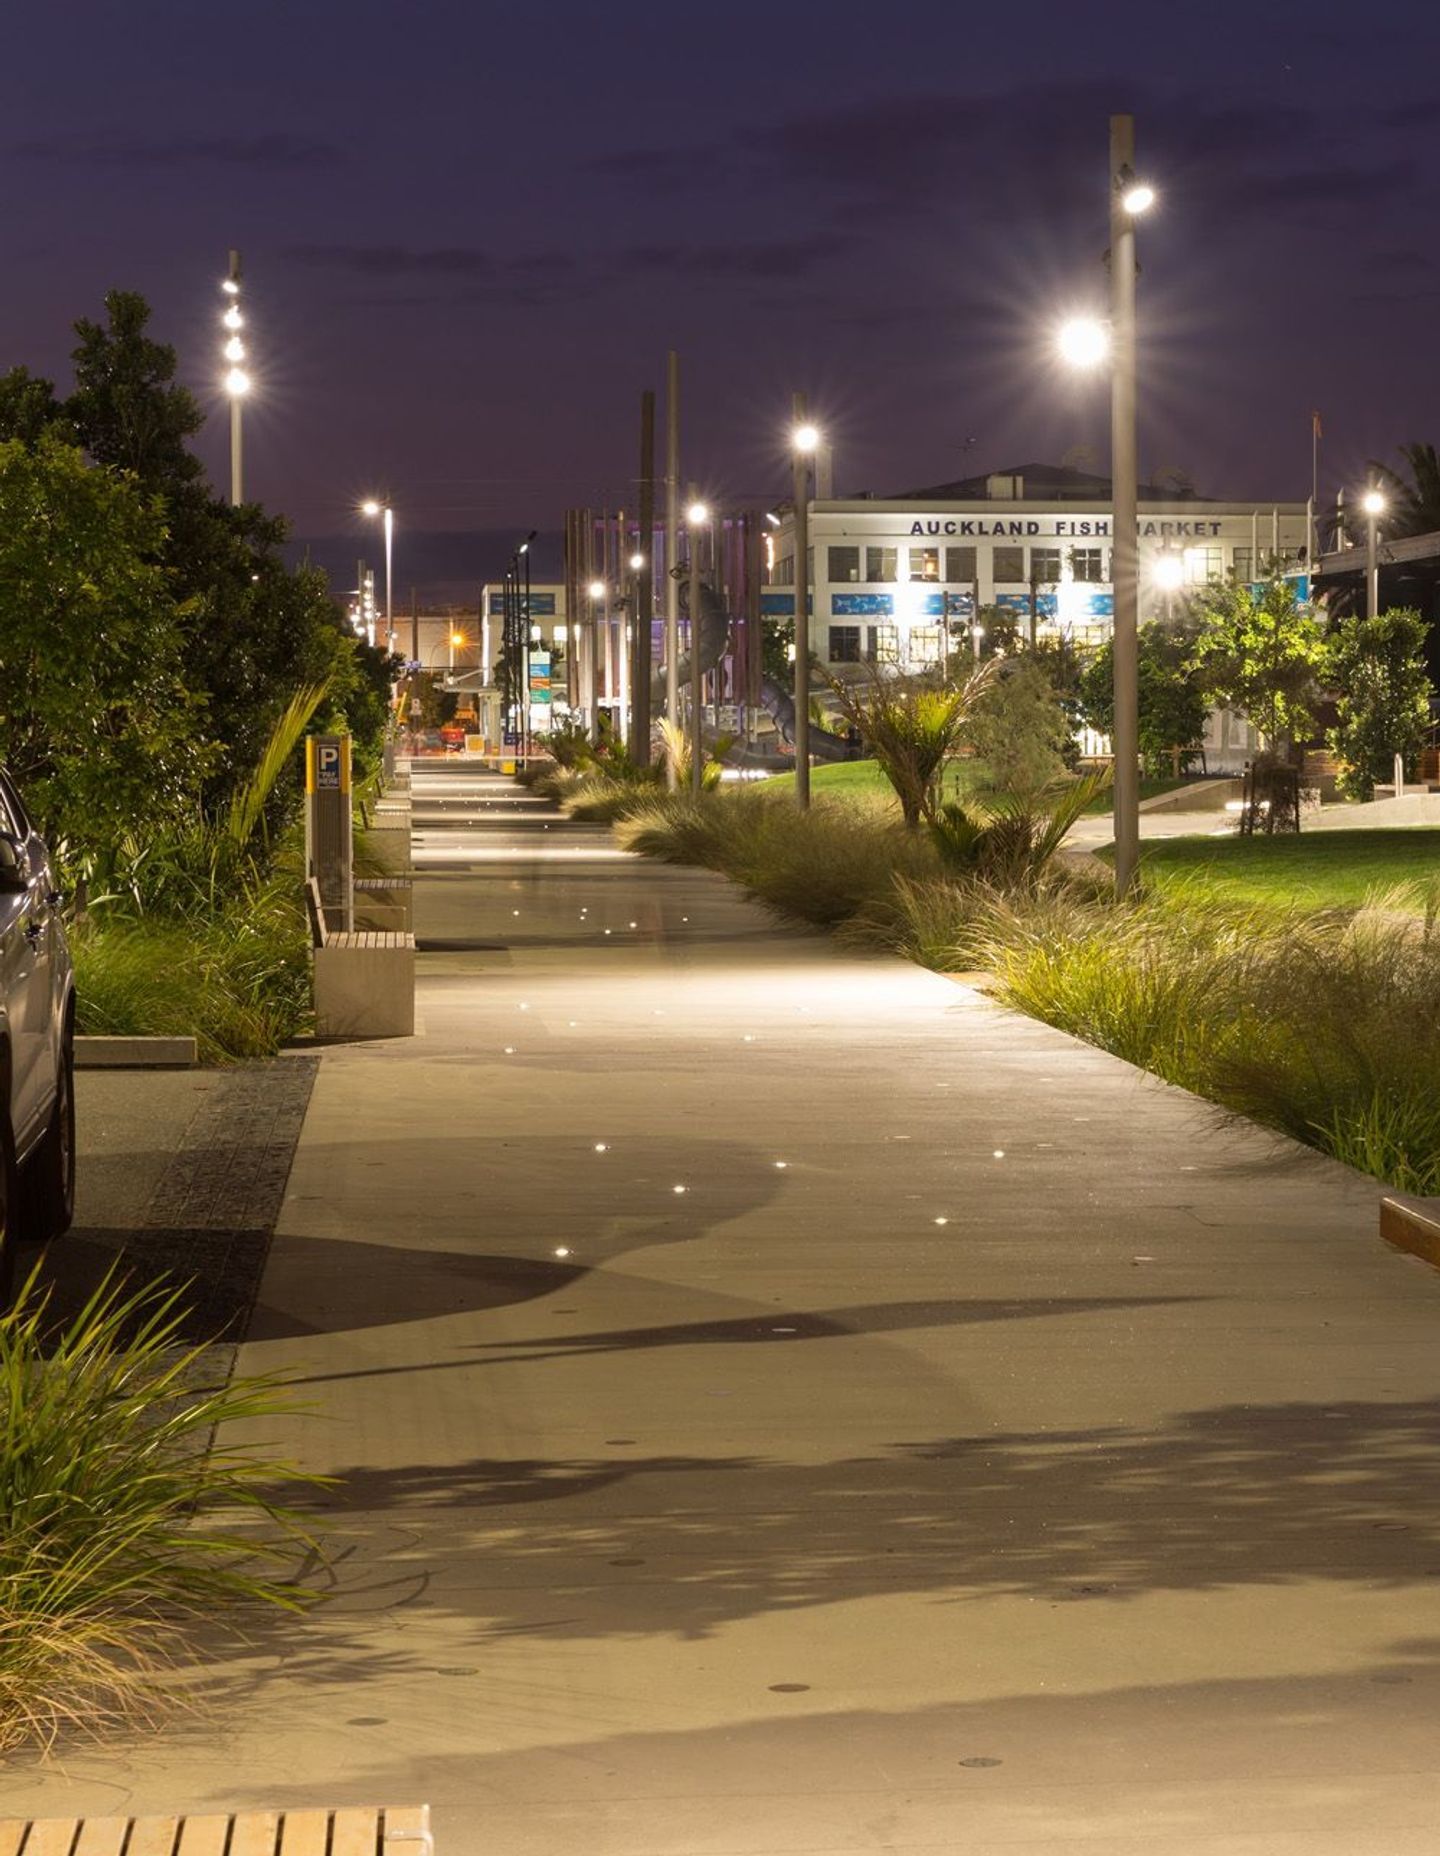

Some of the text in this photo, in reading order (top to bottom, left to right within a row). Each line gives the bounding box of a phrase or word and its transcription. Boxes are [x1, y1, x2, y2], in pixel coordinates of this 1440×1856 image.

[910, 520, 1222, 537] AUCKLAND FISH ARKET
[321, 749, 338, 770] P
